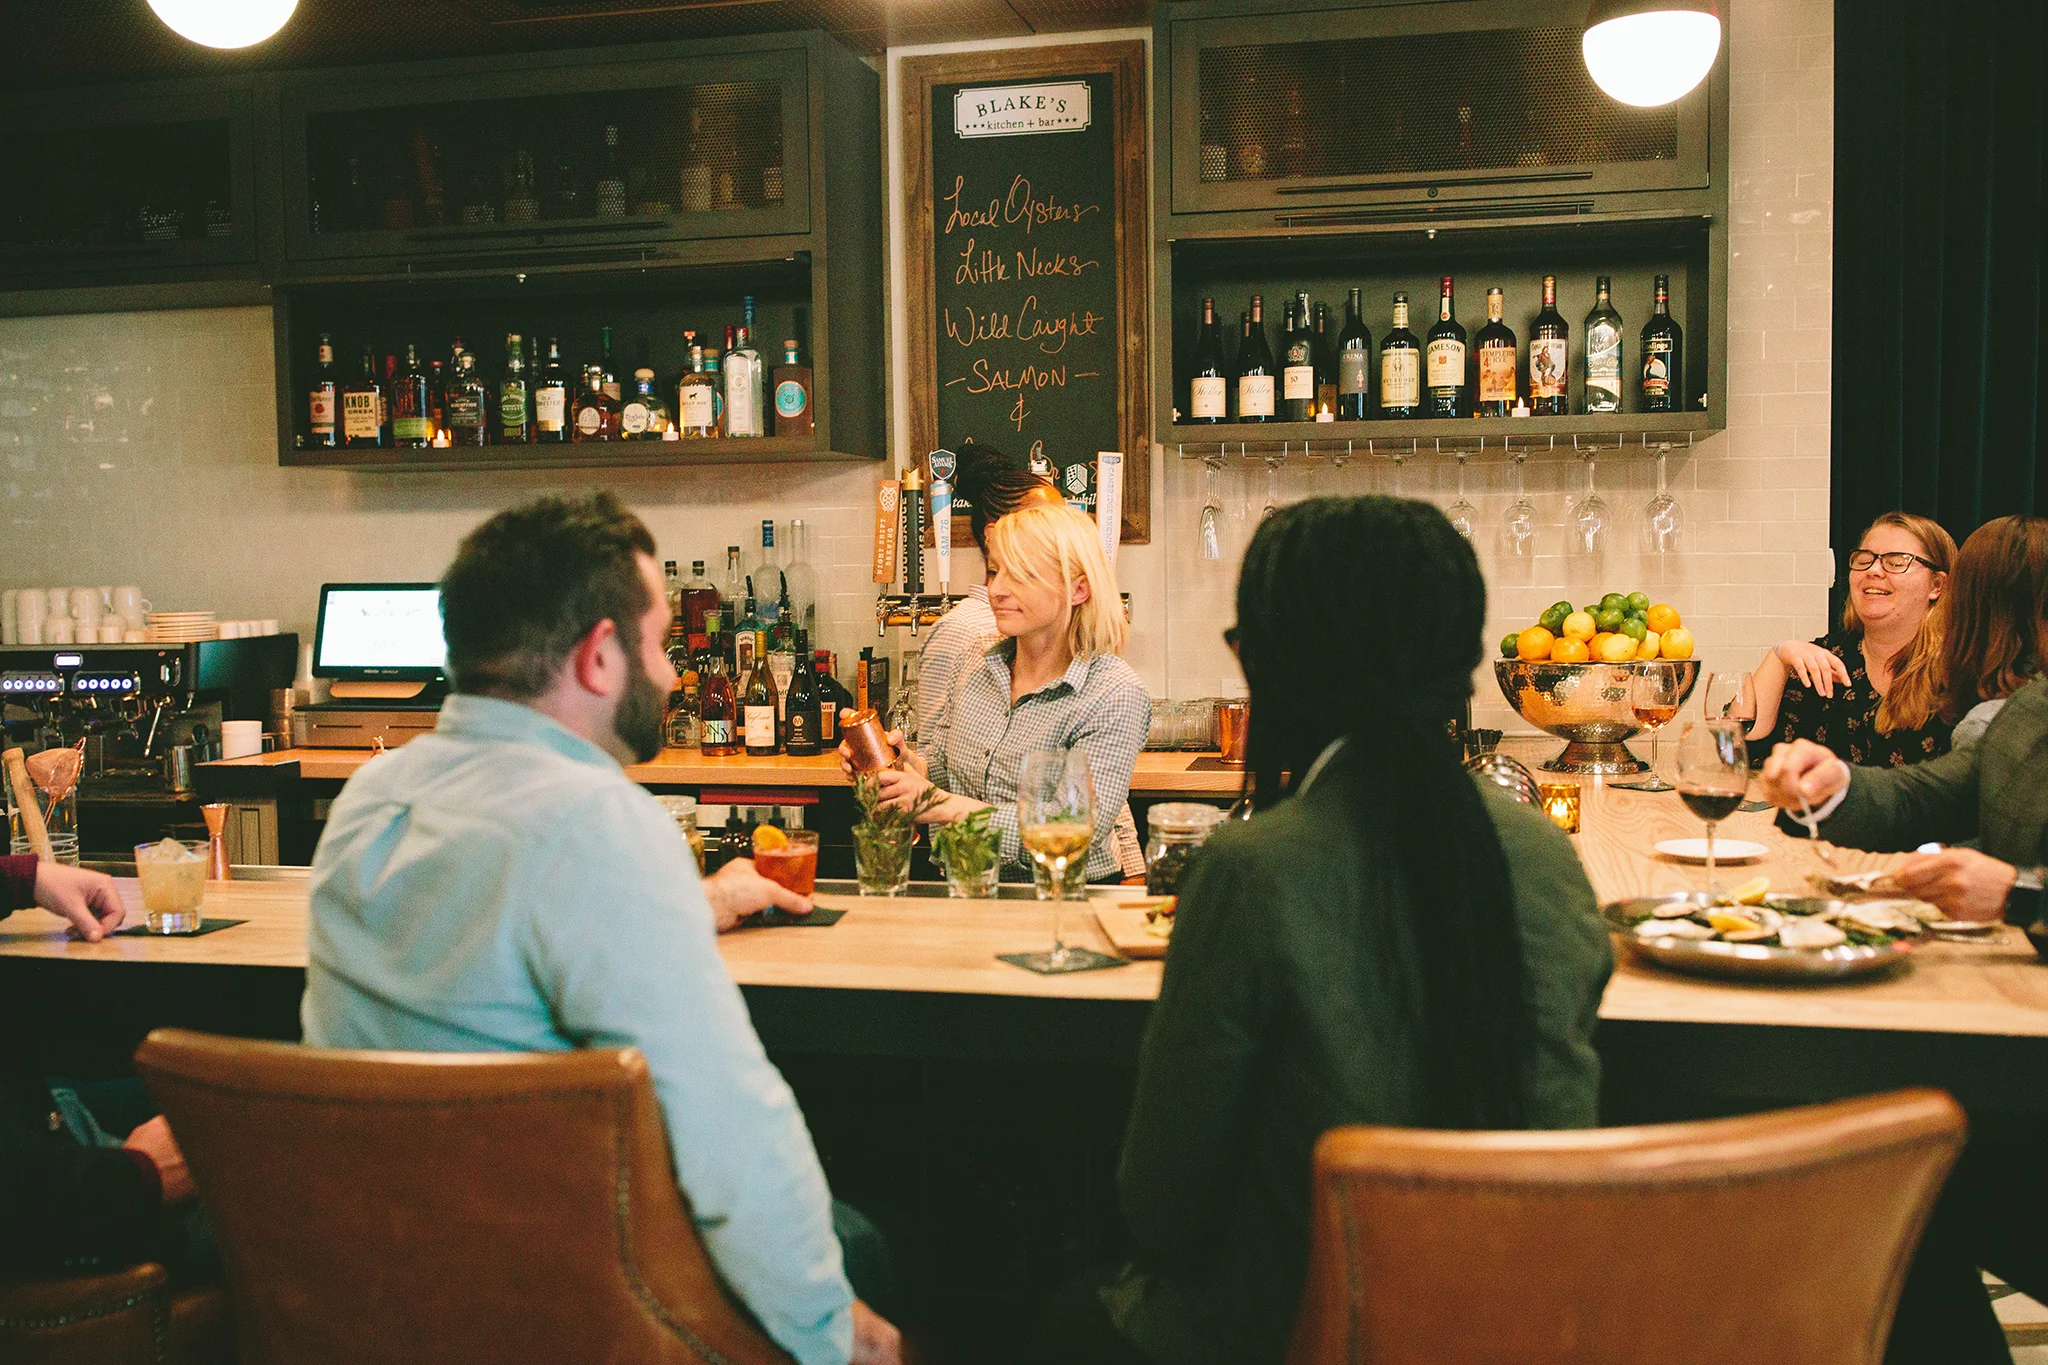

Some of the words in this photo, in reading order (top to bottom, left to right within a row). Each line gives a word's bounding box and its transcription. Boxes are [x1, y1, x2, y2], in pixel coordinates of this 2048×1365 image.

[976, 95, 1067, 118] BLAKE'S
[987, 119, 1024, 130] kitchen
[1038, 117, 1055, 127] bar
[944, 175, 1000, 234] Local
[1005, 174, 1099, 234] Oysters
[956, 238, 1010, 285] Little
[1017, 247, 1099, 281] Necks
[945, 306, 1013, 347] Wild
[1016, 295, 1105, 354] Caught
[1428, 343, 1461, 355] JAMESON
[967, 358, 1066, 393] SALMON
[345, 396, 370, 408] KNOB
[931, 456, 954, 464] SAMUEL
[934, 461, 953, 469] ADAMS
[1106, 467, 1115, 514] CAMBRIDGE
[878, 518, 886, 545] SHIFT
[941, 519, 949, 534] '76
[1105, 514, 1114, 554] BREWING
[885, 527, 894, 566] BREWING
[941, 535, 949, 556] SAM
